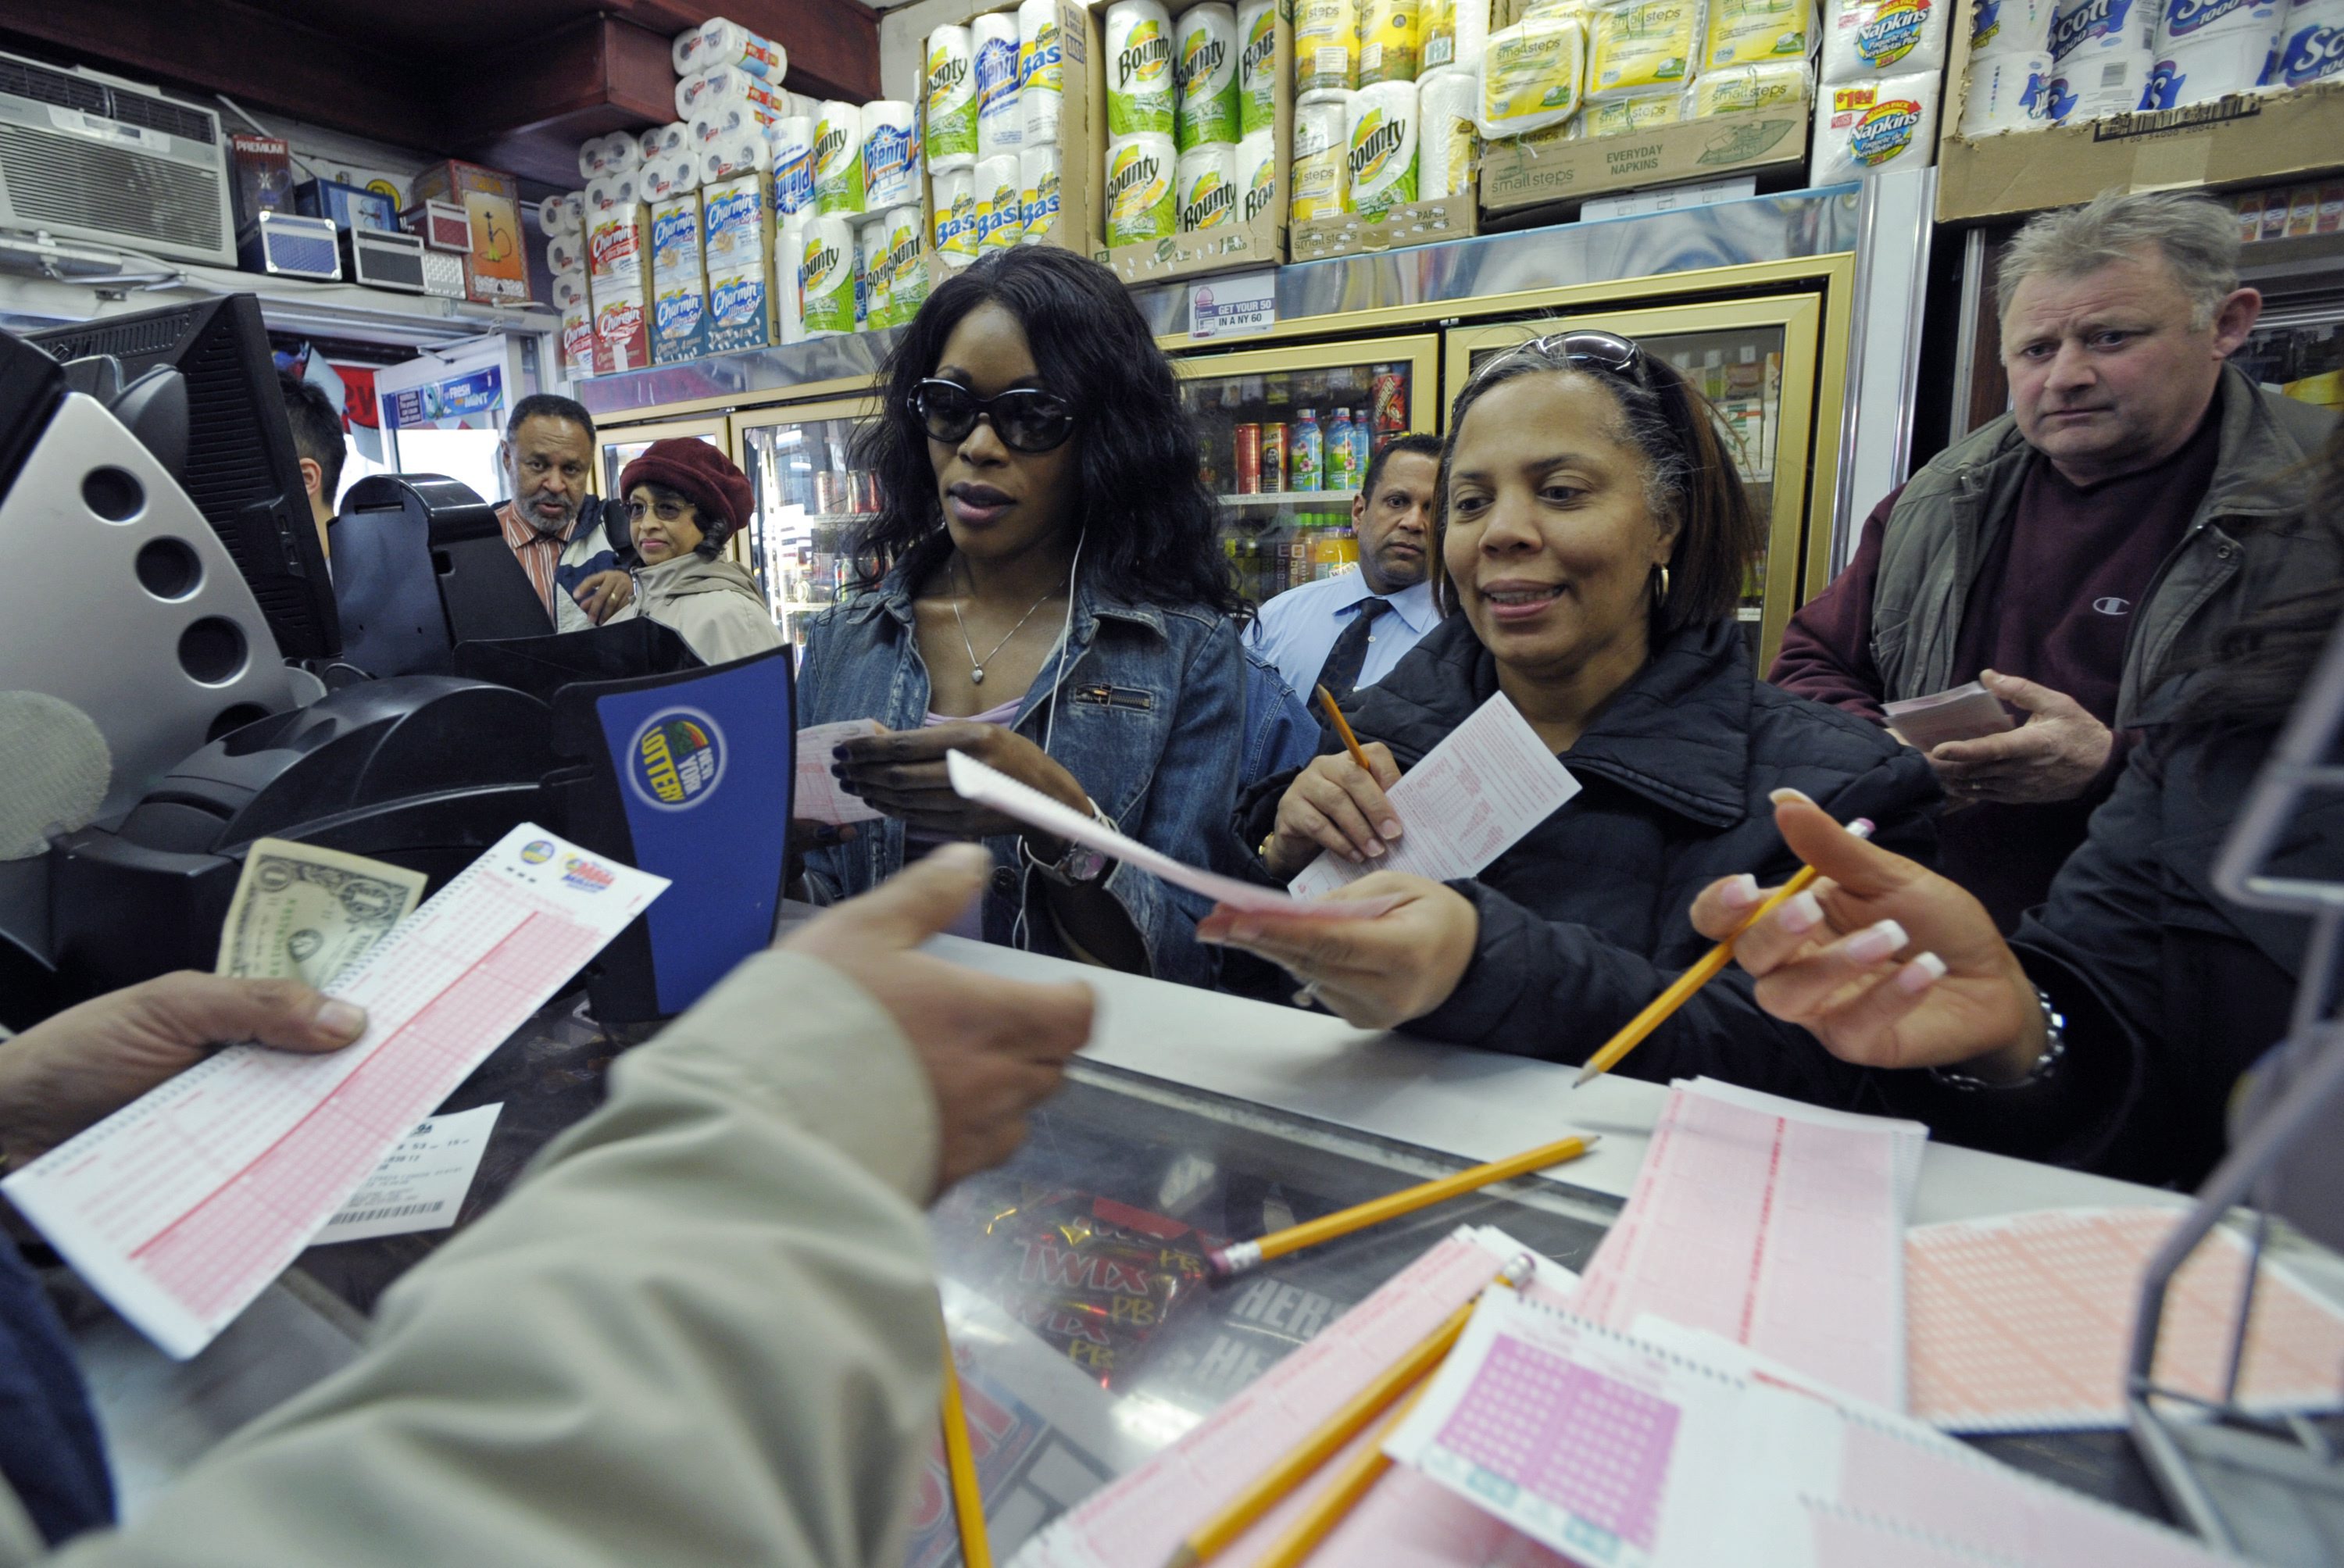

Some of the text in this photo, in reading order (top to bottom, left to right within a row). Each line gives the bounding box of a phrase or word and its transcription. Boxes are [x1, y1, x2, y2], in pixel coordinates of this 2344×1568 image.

[1308, 5, 1339, 18] steps
[1645, 8, 1681, 23] steps
[1855, 9, 1928, 44] Napkins
[1118, 36, 1171, 89] Bounty
[1528, 39, 1560, 54] steps
[2294, 27, 2344, 72] Sc
[1021, 45, 1062, 87] Bas
[1176, 38, 1226, 109] Bounty
[1750, 84, 1787, 98] steps
[1633, 104, 1667, 119] steps
[1846, 111, 1919, 145] Napkins
[235, 140, 287, 155] PREMIUM
[866, 138, 909, 184] Plenty
[1347, 117, 1406, 185] Bounty
[1606, 144, 1663, 163] EVERYDAY
[1304, 167, 1335, 182] steps
[1492, 169, 1574, 193] small steps
[1610, 158, 1659, 175] NAPKINS
[1106, 155, 1159, 220] Bounty
[1245, 181, 1274, 221] Bou
[707, 194, 753, 231] Charmin
[978, 198, 1023, 244] Basi
[1022, 195, 1060, 232] Bas
[1184, 180, 1236, 232] Bounty
[592, 223, 631, 259] Charmin
[655, 213, 695, 248] Charmin
[937, 213, 976, 251] Bas
[887, 236, 920, 284] Bount
[656, 294, 699, 326] Charmin
[688, 306, 702, 323] Sof
[713, 282, 757, 317] Charmin
[745, 294, 763, 311] Sof
[1218, 299, 1272, 316] GET YOUR 50
[1218, 313, 1262, 327] IN A NY 60
[641, 725, 686, 802] LOTTERY
[677, 753, 702, 796] YORK
[697, 746, 715, 780] NEW
[1014, 1238, 1149, 1295] TWIX
[1159, 1249, 1201, 1273] PB
[1111, 1294, 1156, 1326] PB
[1068, 1340, 1115, 1370] PB
